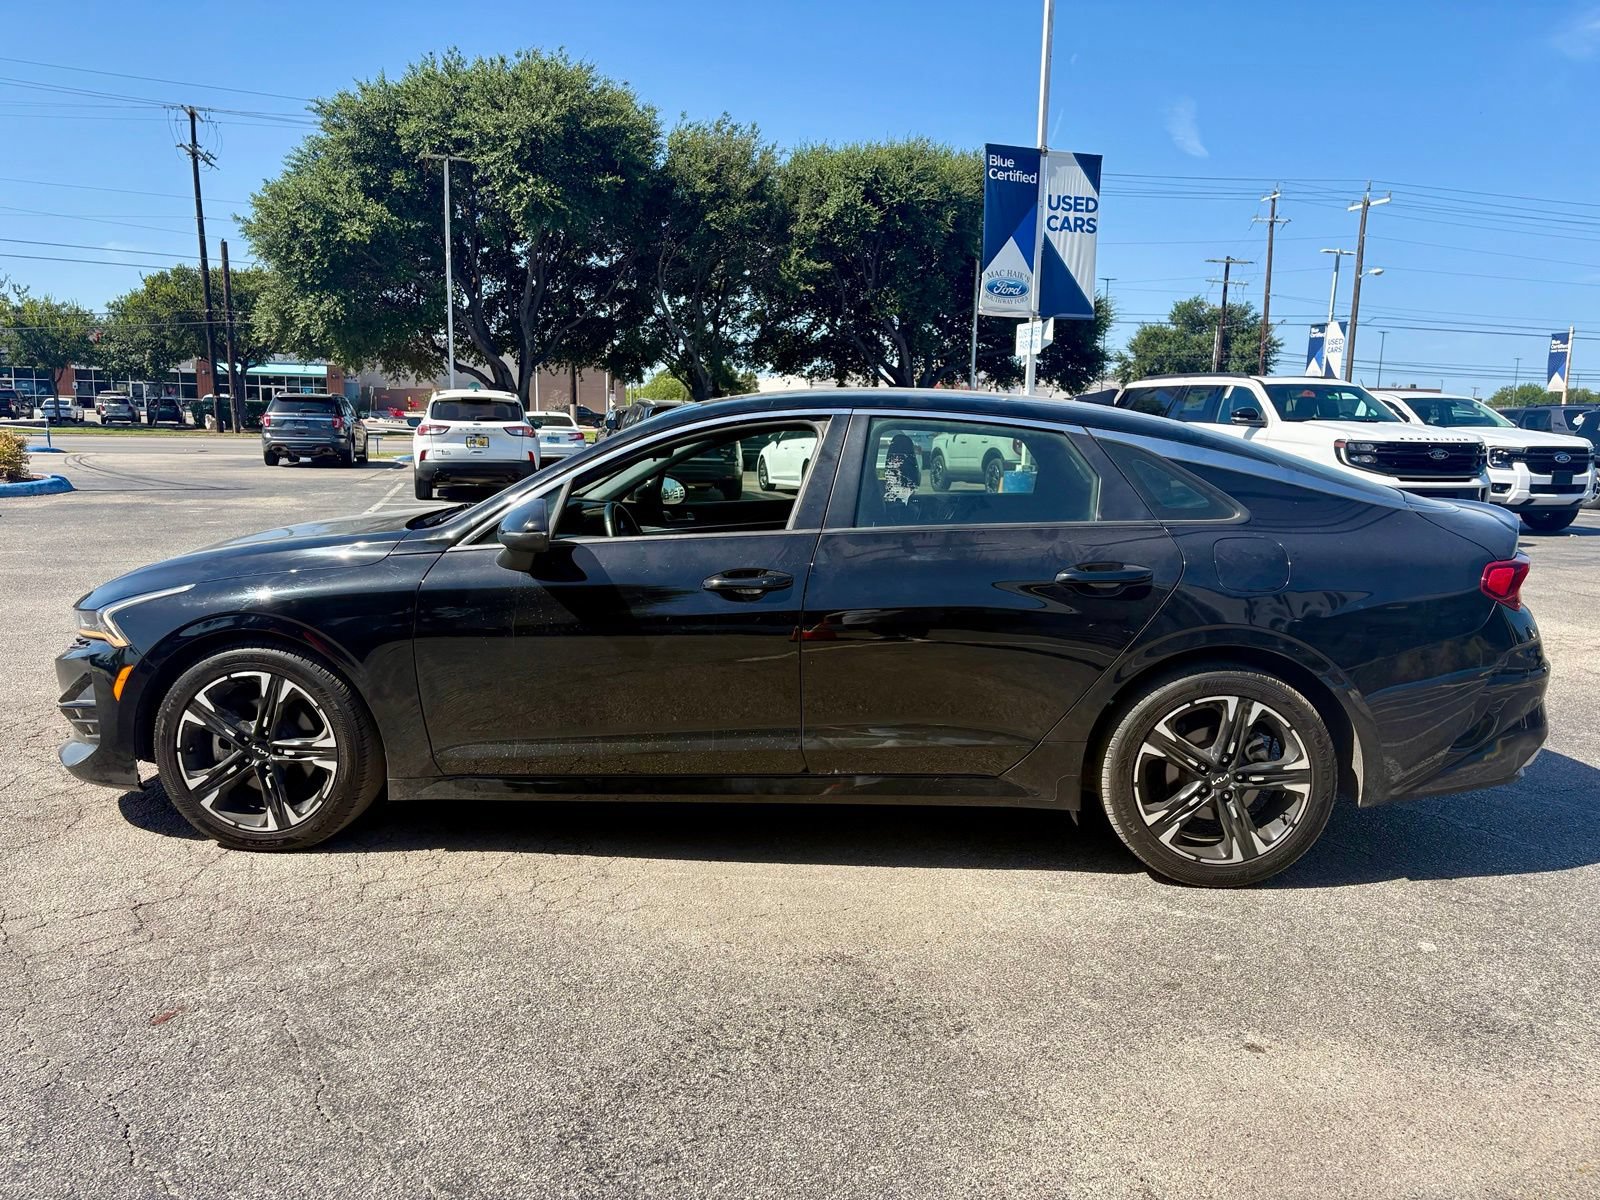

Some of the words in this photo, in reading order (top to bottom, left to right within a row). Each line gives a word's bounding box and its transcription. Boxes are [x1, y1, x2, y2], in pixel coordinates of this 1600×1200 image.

[989, 154, 1015, 168] Blue
[988, 168, 1038, 184] Certified
[1047, 194, 1099, 213] USED
[1046, 215, 1098, 234] CARS
[987, 269, 1005, 279] MAC
[993, 280, 1023, 295] Ford
[1327, 337, 1344, 346] USED
[1326, 345, 1343, 353] CARS
